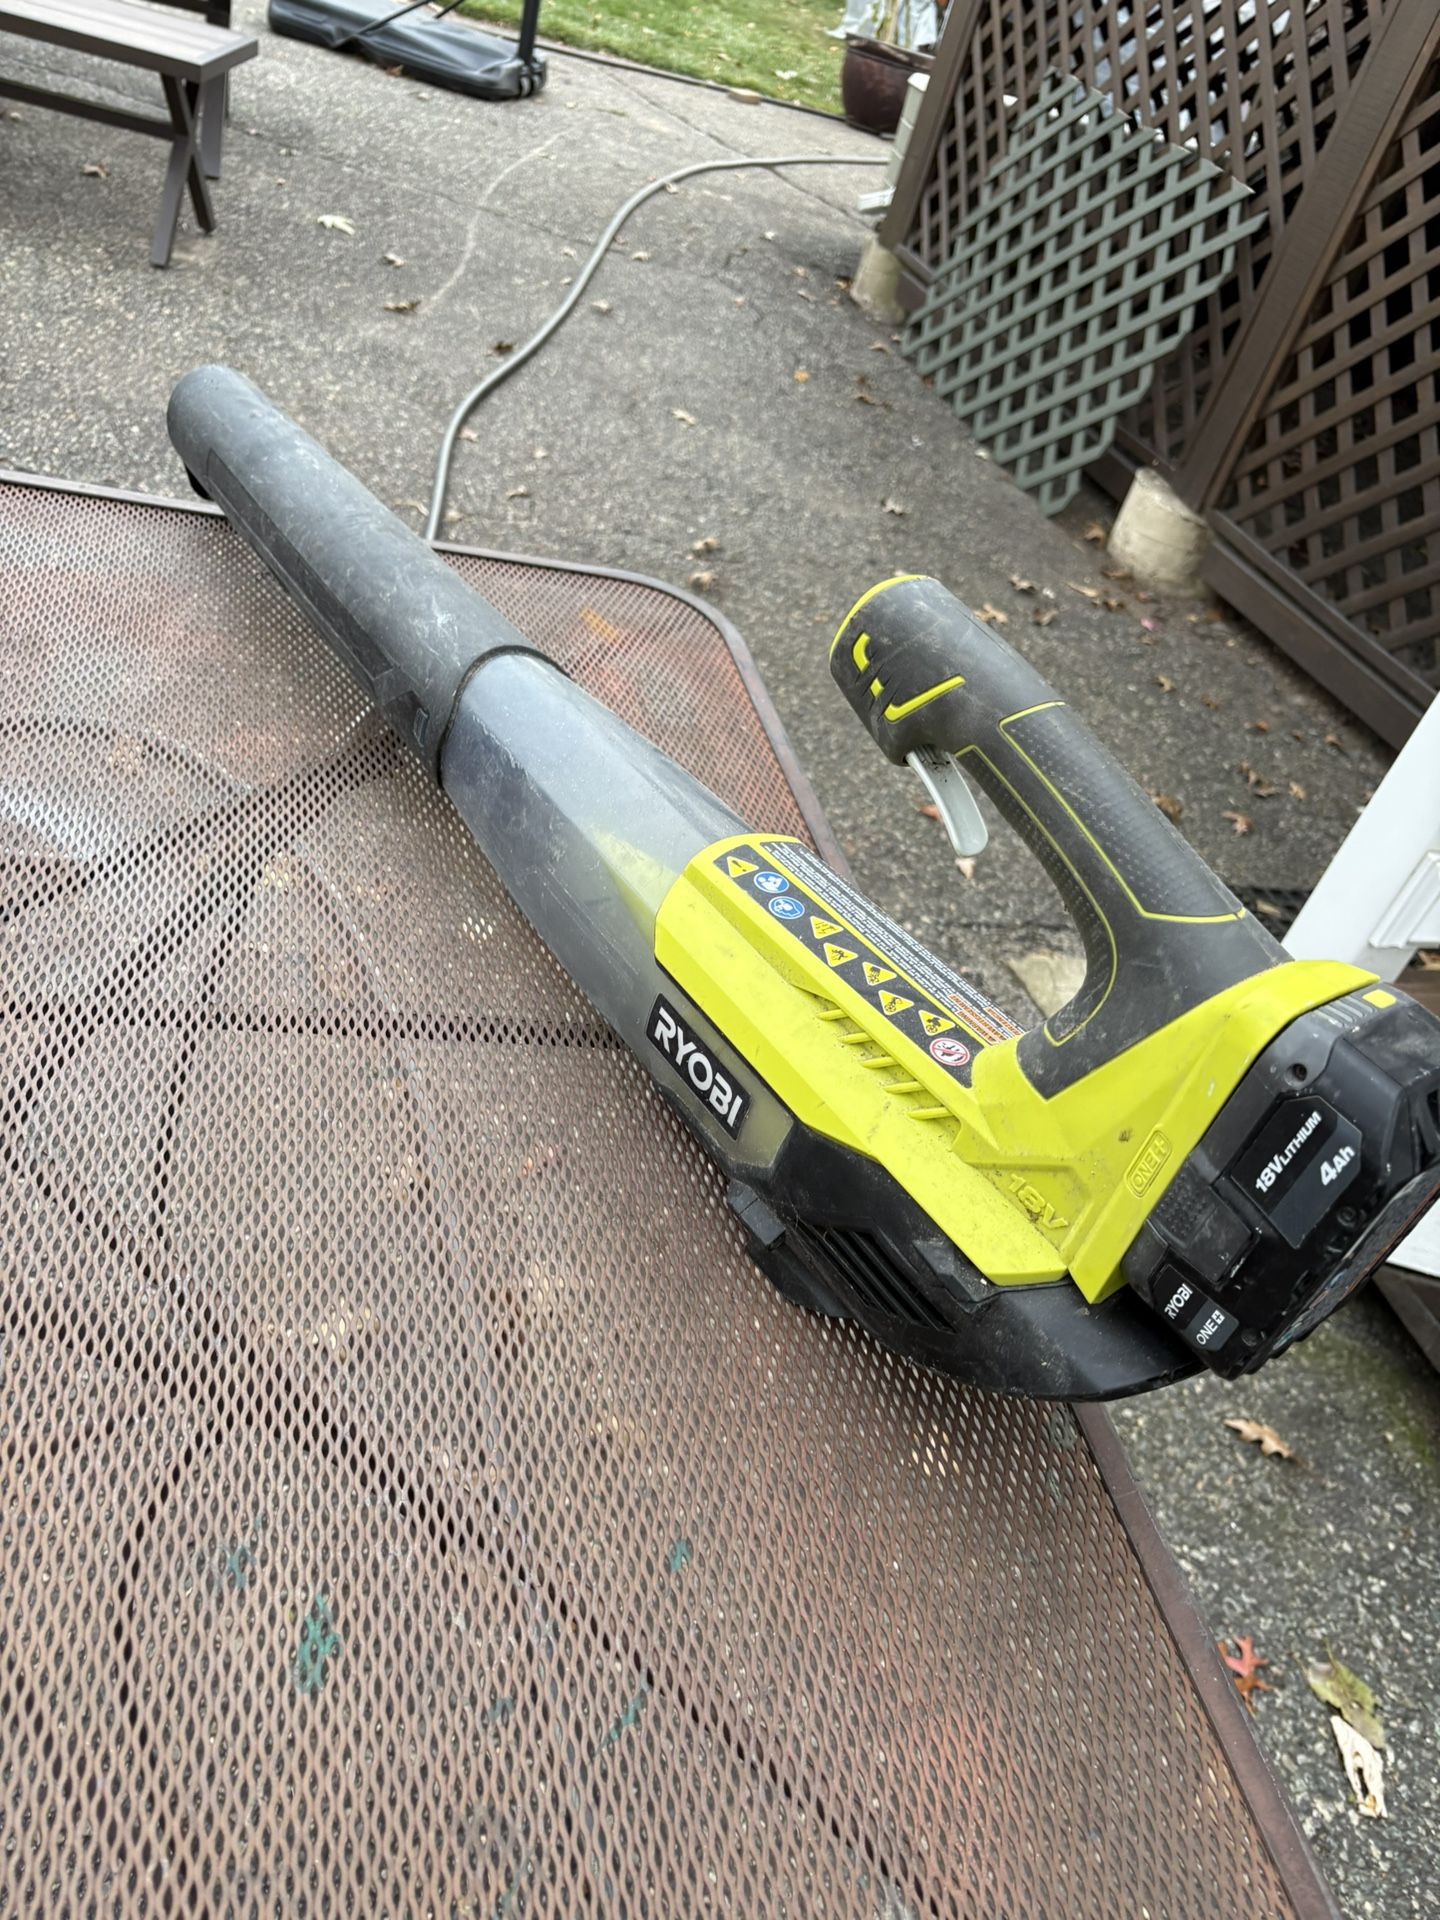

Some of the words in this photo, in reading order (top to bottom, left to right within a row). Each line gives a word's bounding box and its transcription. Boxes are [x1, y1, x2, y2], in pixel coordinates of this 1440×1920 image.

[654, 1006, 743, 1128] RYOBI
[1320, 1146, 1355, 1186] 4Ah
[1008, 1173, 1069, 1229] 18V
[1164, 1283, 1193, 1320] RYOBI
